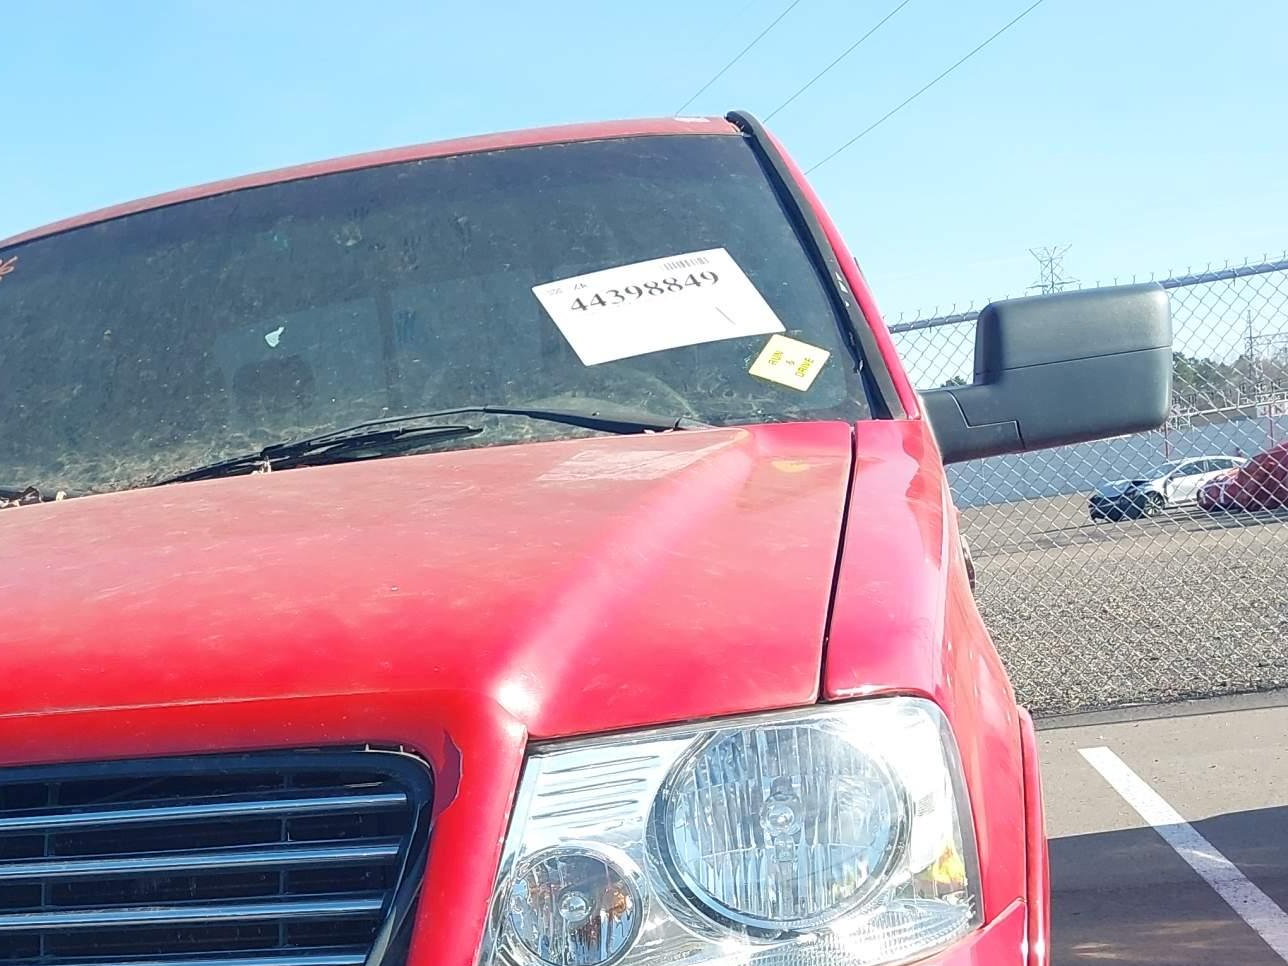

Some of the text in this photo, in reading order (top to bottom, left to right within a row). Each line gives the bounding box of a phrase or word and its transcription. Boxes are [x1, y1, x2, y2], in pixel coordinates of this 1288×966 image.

[569, 270, 720, 312] 44398849
[767, 349, 784, 366] RUN
[794, 356, 814, 378] DRIVE
